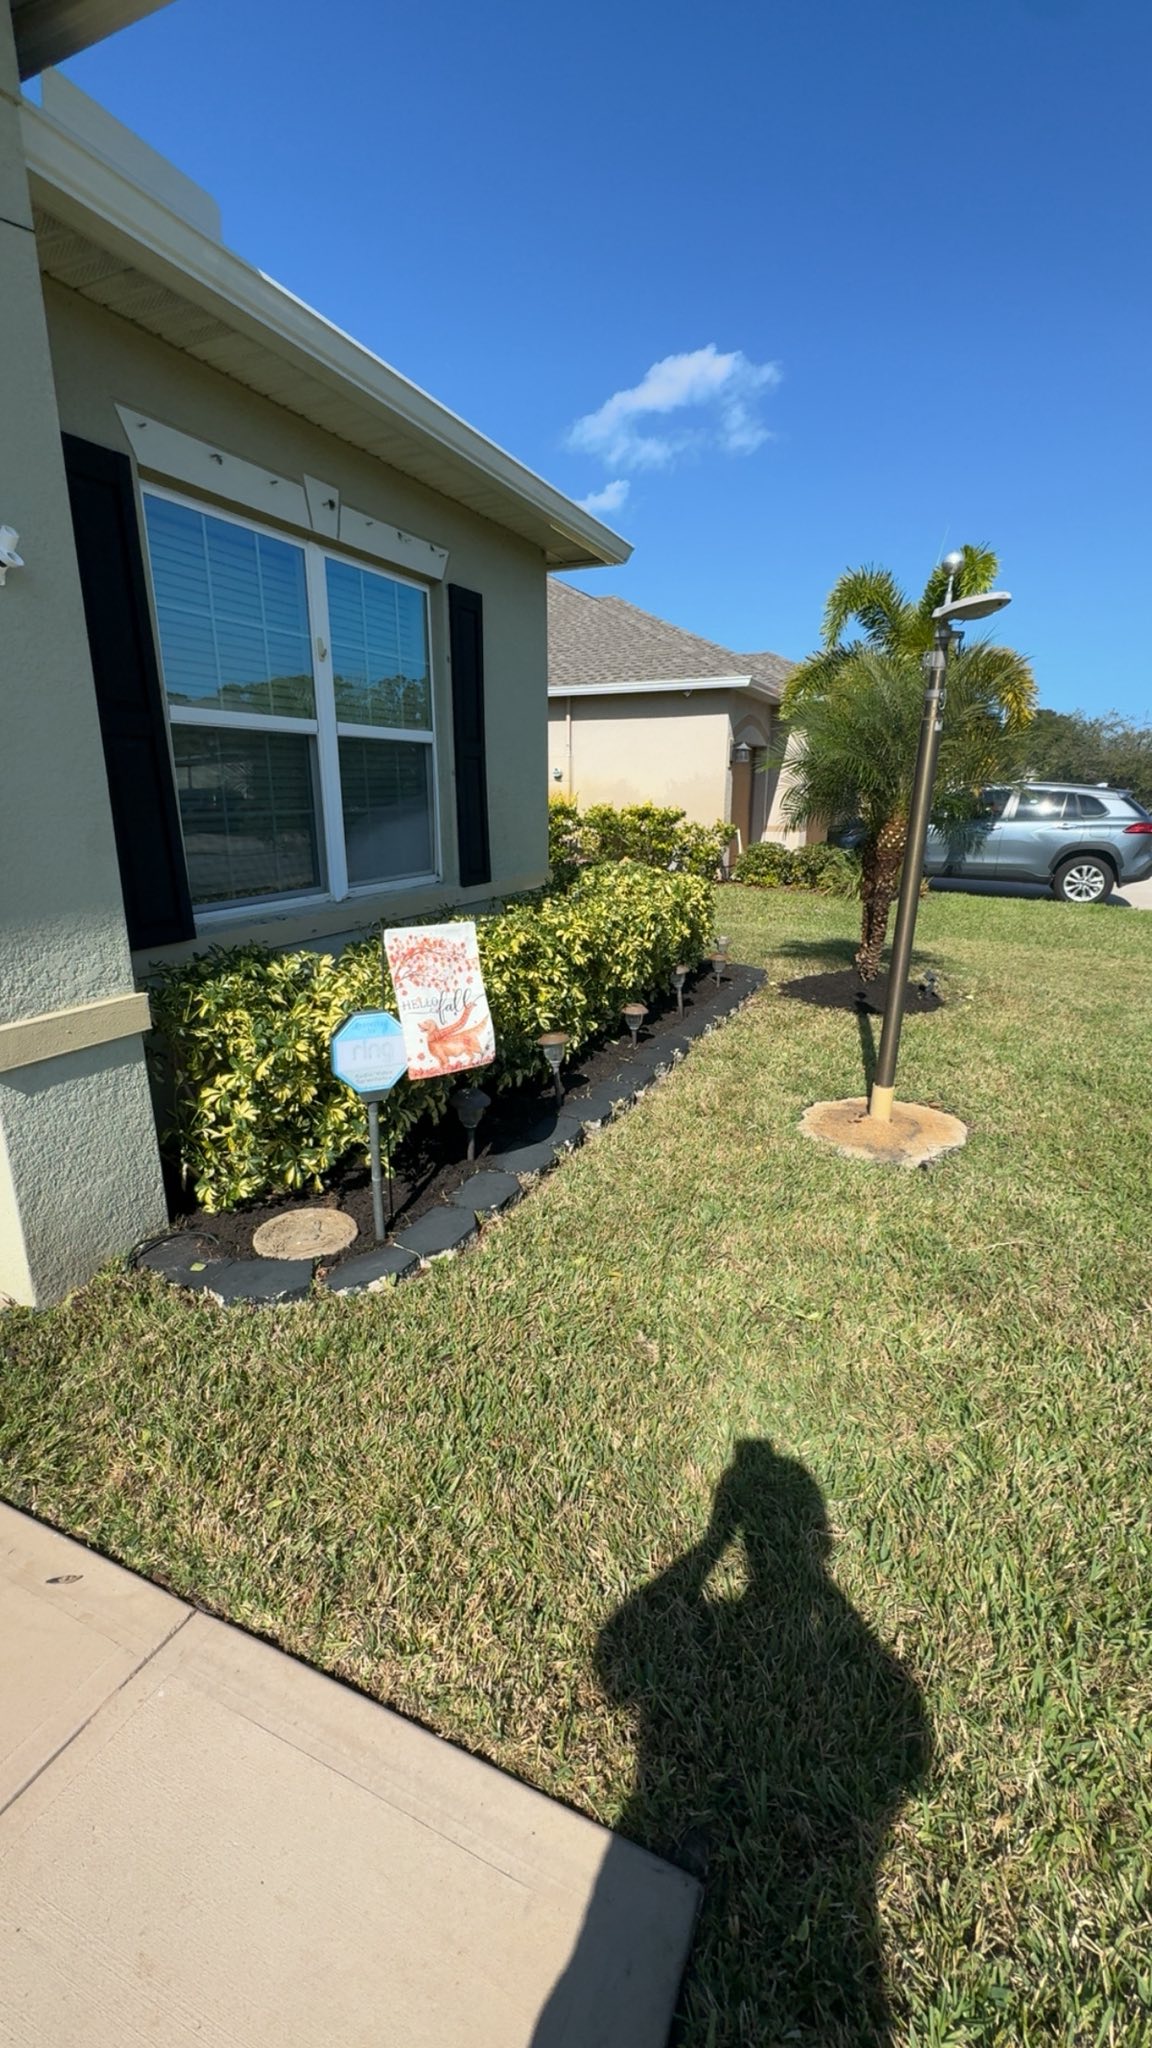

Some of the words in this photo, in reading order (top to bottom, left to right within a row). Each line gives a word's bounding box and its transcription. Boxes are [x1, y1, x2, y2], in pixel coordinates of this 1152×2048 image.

[402, 996, 439, 1011] HELLO
[438, 988, 480, 1025] fall
[352, 1039, 393, 1064] ring
